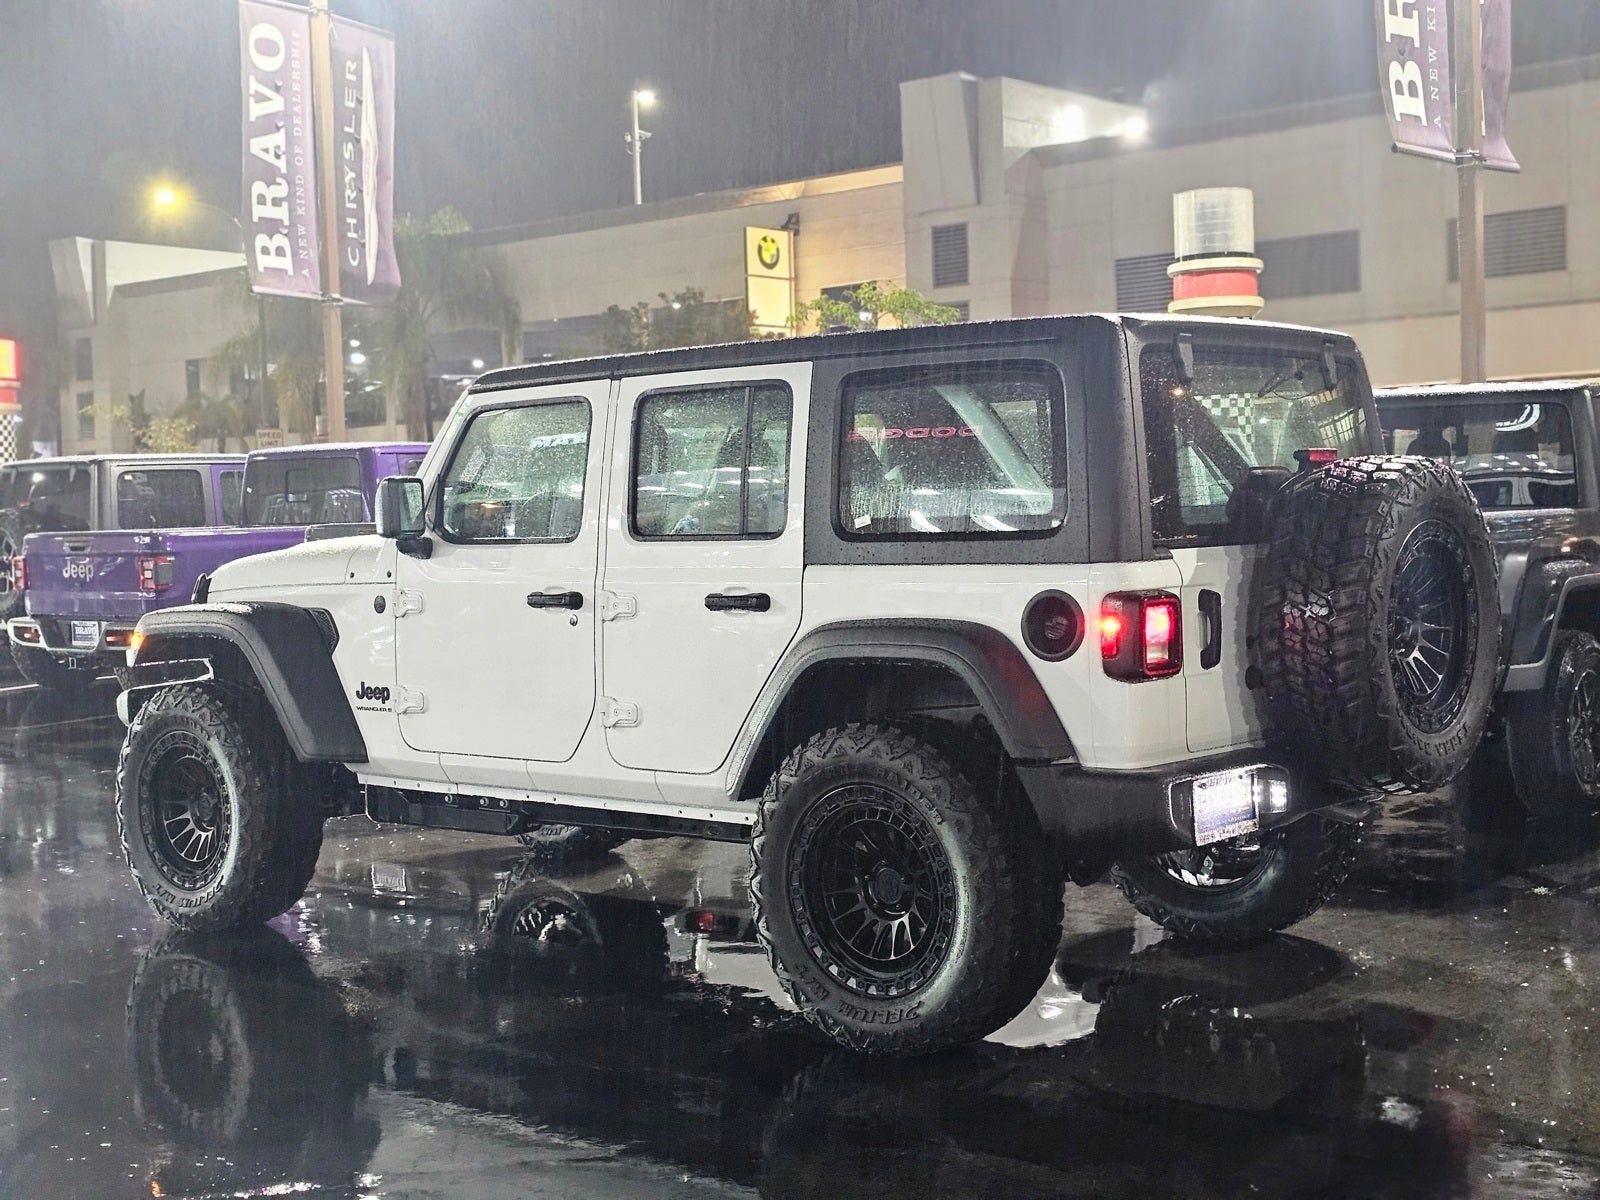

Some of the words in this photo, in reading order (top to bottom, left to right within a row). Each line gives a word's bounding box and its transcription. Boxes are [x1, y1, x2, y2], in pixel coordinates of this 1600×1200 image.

[291, 28, 303, 137] DEALERSHIP
[1428, 44, 1440, 101] NEW
[1433, 115, 1442, 129] A
[293, 145, 304, 167] OF
[343, 59, 360, 267] CHRYSLER
[295, 174, 306, 216] KIND
[297, 223, 309, 260] NEW
[301, 268, 310, 278] A
[258, 431, 282, 439] SPEED
[62, 557, 94, 582] Jeep
[355, 681, 391, 704] Jeep
[356, 705, 387, 713] WRANGLER
